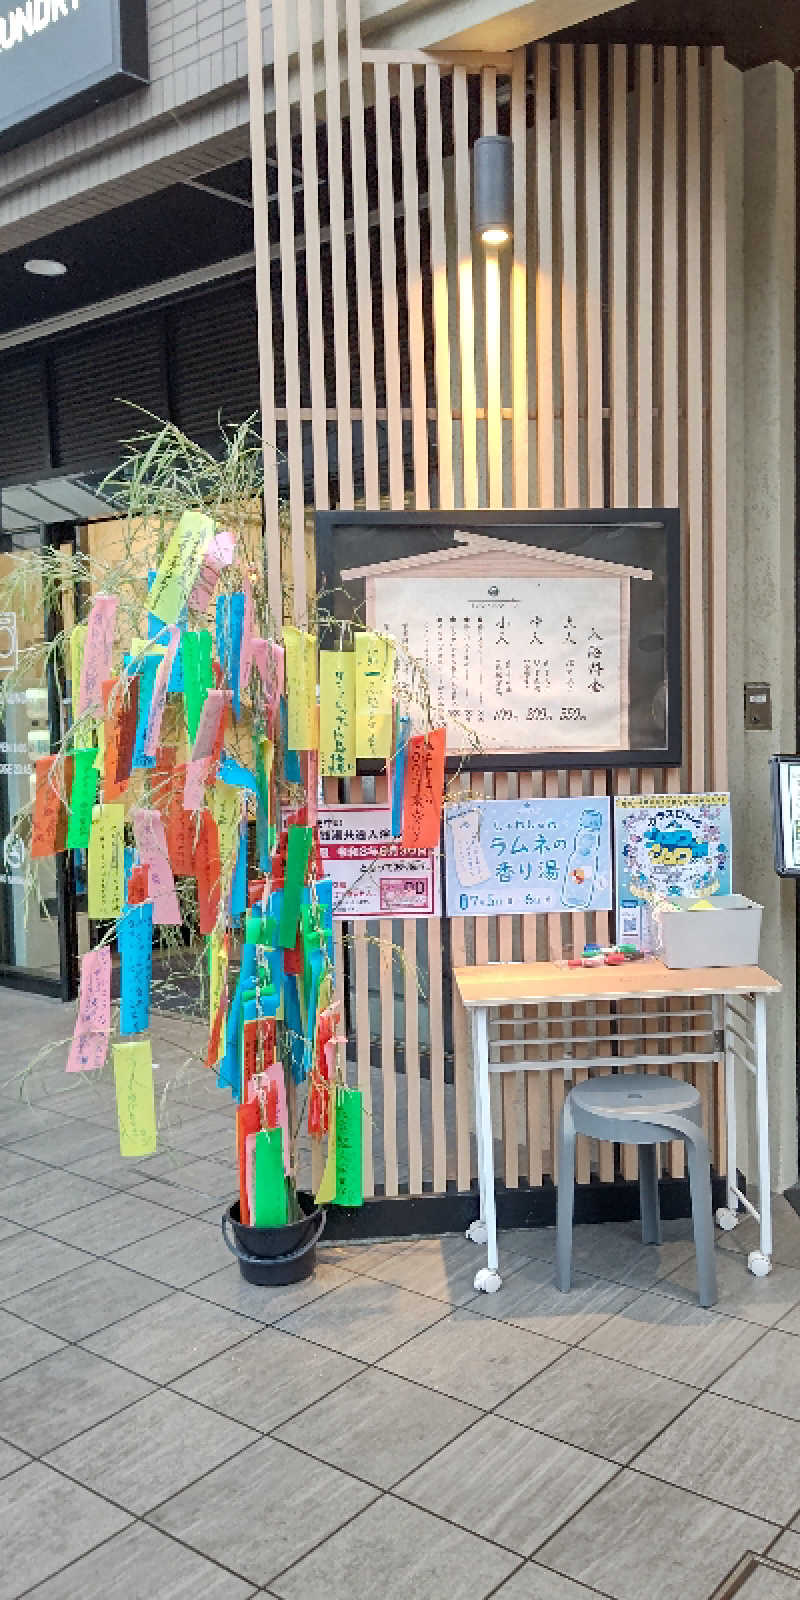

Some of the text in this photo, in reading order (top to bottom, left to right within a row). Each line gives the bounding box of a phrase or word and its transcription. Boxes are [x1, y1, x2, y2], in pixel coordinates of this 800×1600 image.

[490, 833, 567, 857] ラムネの
[495, 859, 561, 883] 香り湯
